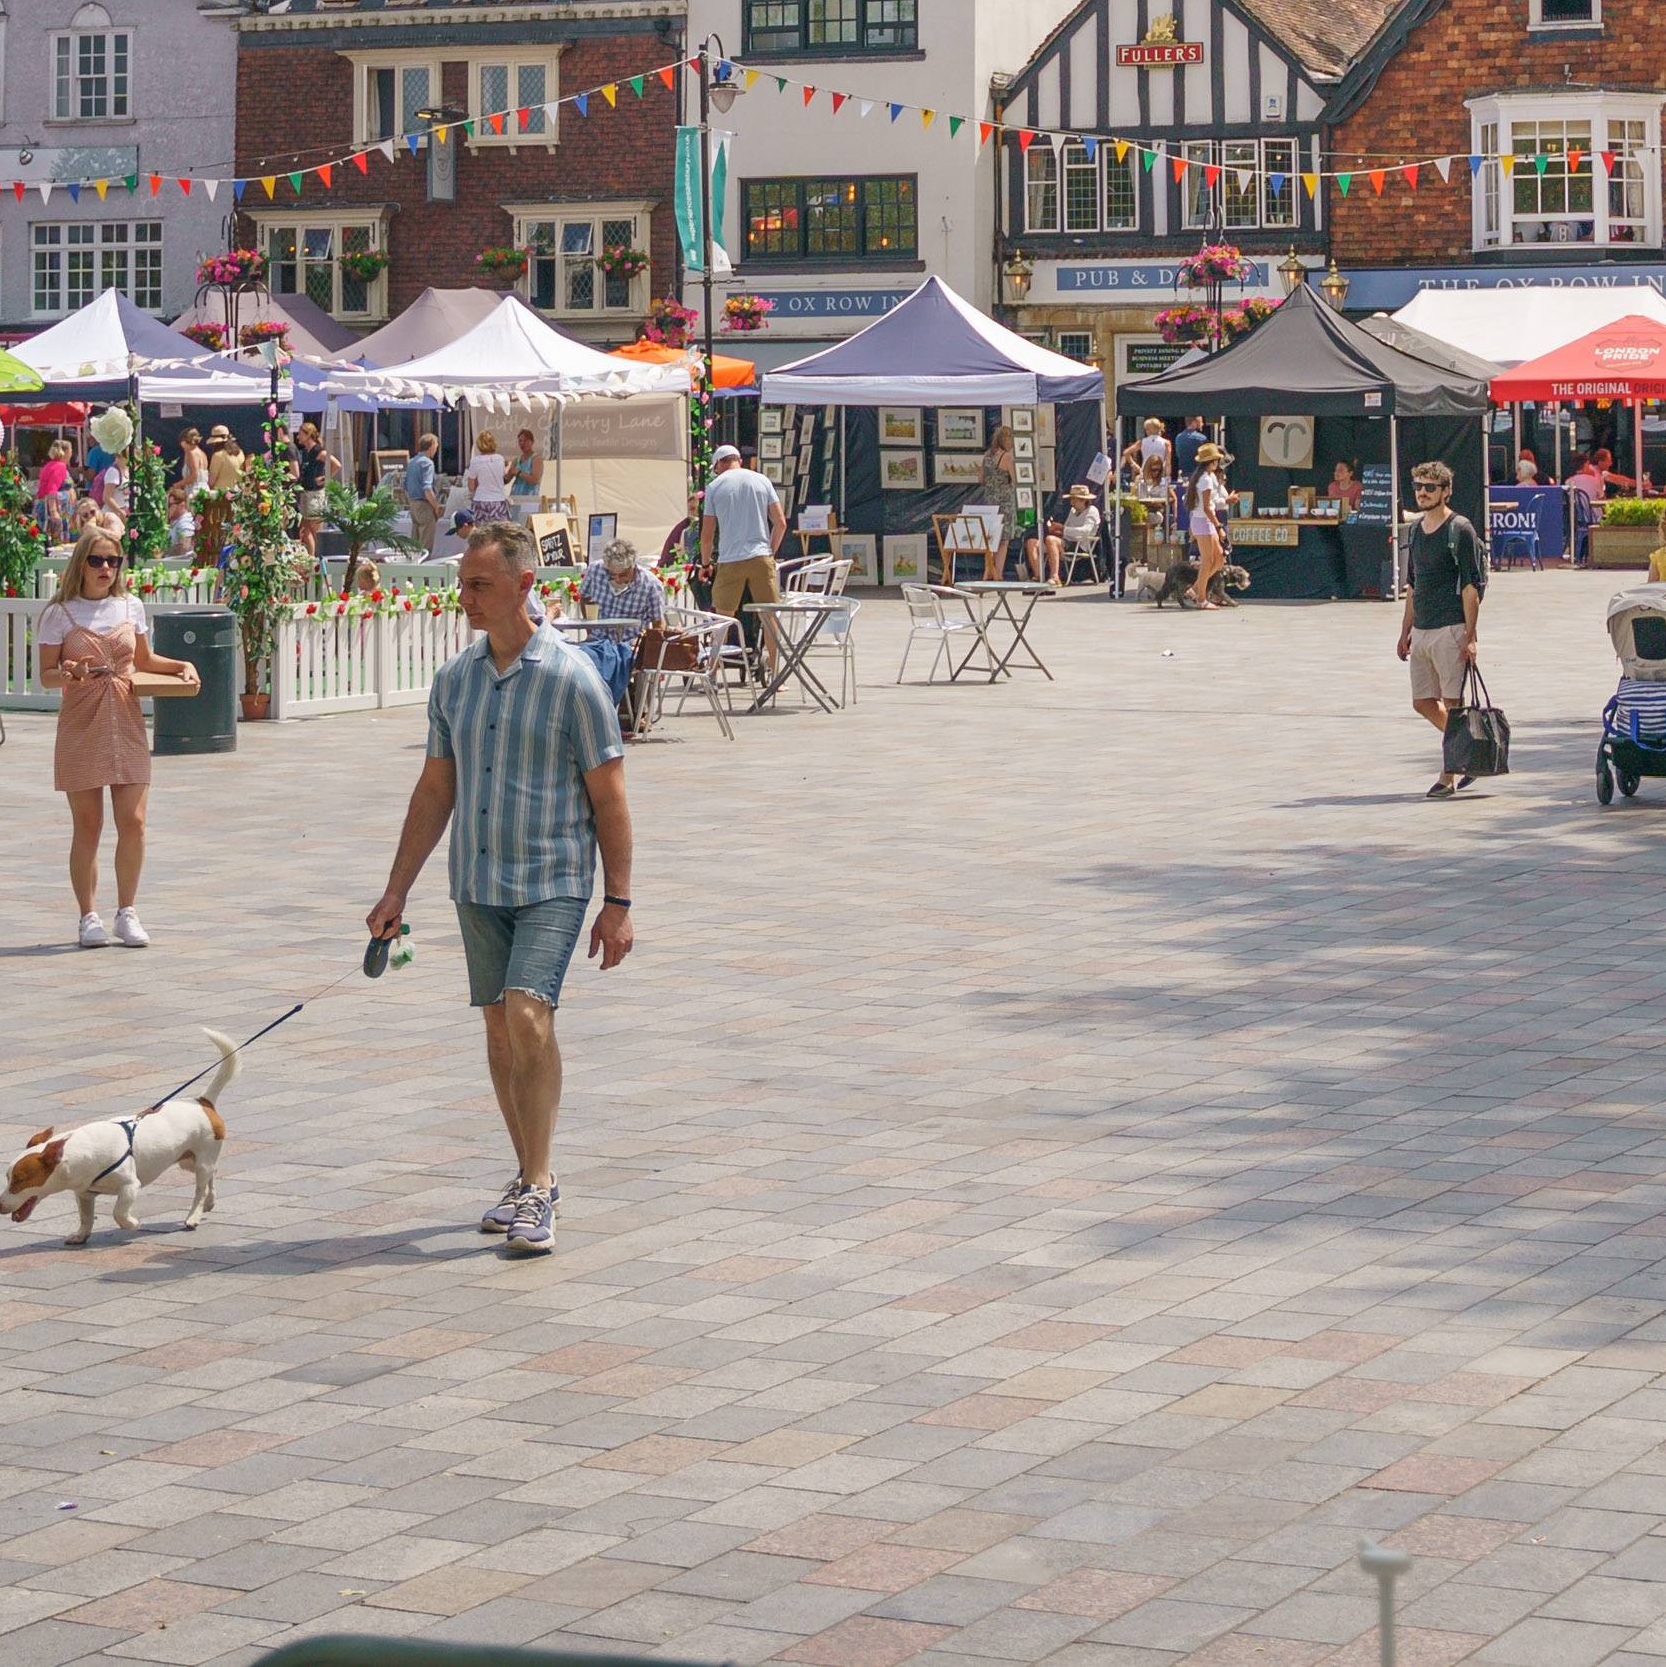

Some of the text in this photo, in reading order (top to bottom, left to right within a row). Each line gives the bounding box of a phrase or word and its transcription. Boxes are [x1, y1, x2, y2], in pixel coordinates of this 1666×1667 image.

[1121, 45, 1197, 62] FULLER'S
[1075, 270, 1119, 286] PUB
[1131, 269, 1149, 284] &
[789, 297, 816, 311] OX
[826, 296, 873, 311] ROW
[1594, 346, 1661, 355] LONDON
[1602, 353, 1650, 361] PRIDE
[1551, 383, 1574, 395] THE
[1576, 382, 1632, 395] ORIGINAL
[483, 413, 666, 434] Little Cuntry Lane
[1232, 527, 1288, 542] COFFEE CO
